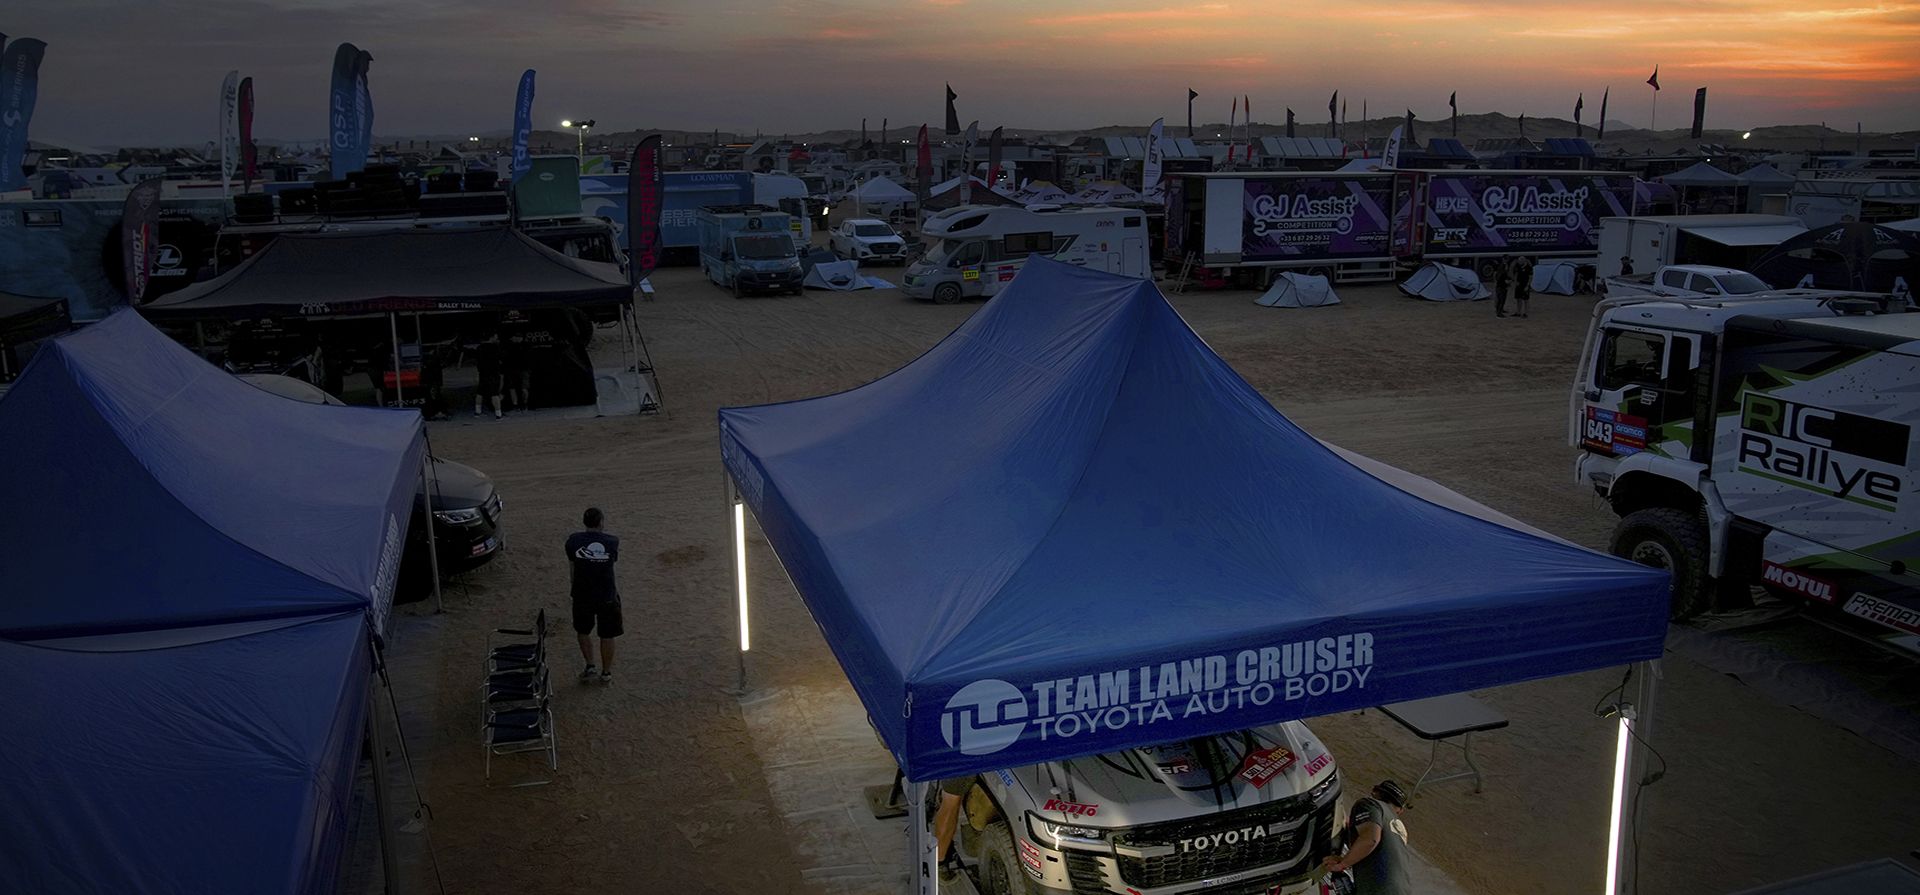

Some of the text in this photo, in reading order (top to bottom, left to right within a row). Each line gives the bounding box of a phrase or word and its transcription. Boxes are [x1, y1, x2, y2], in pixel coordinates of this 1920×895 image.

[334, 95, 348, 149] QSP
[1253, 194, 1289, 219] CJ
[1435, 197, 1469, 213] HEXIS
[1482, 186, 1519, 213] CJ
[1277, 221, 1333, 230] COMPETITION
[1505, 216, 1561, 225] COMPETITION
[1586, 418, 1613, 444] 643
[1742, 394, 1837, 449] RIC
[1739, 432, 1901, 503] Rallye
[1764, 565, 1833, 601] MOTUL
[1033, 632, 1375, 718] TEAM LAND CRUISER
[1033, 665, 1374, 742] TOYOTA AUTO BODY
[1267, 748, 1289, 760] 2025
[1158, 764, 1190, 775] GR
[1179, 824, 1267, 853] TOYOTA
